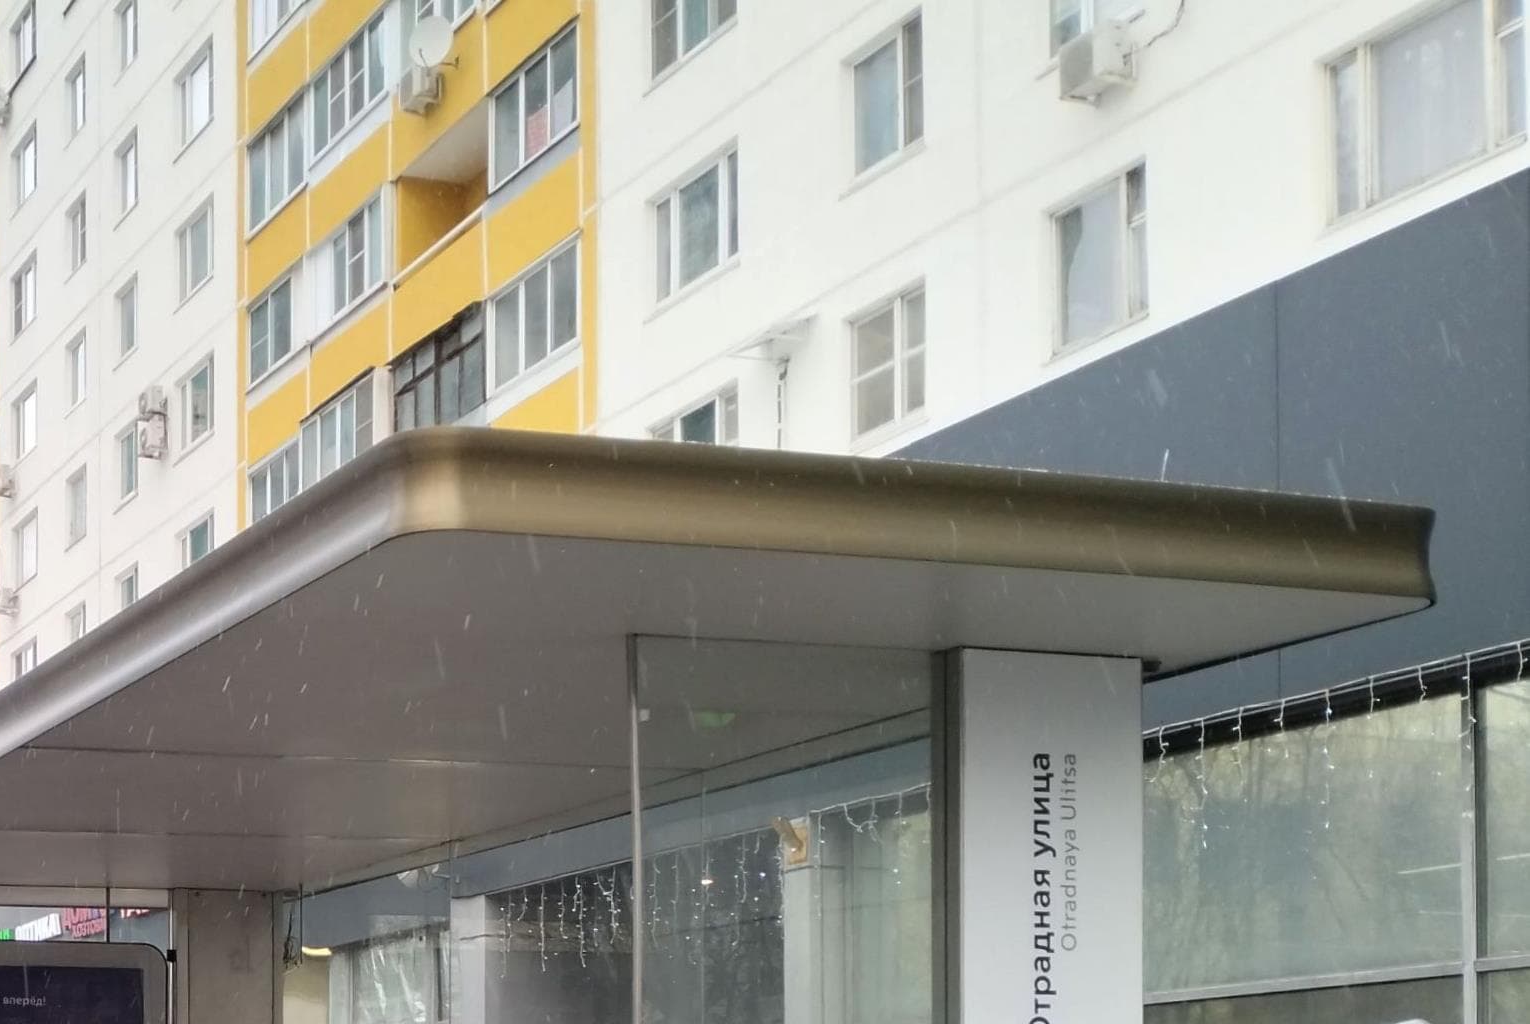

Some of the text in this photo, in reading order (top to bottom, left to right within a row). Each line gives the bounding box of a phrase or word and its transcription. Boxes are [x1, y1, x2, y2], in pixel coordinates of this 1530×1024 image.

[1033, 752, 1057, 858] улица
[1060, 753, 1080, 952] Otradnaya Ulitsa
